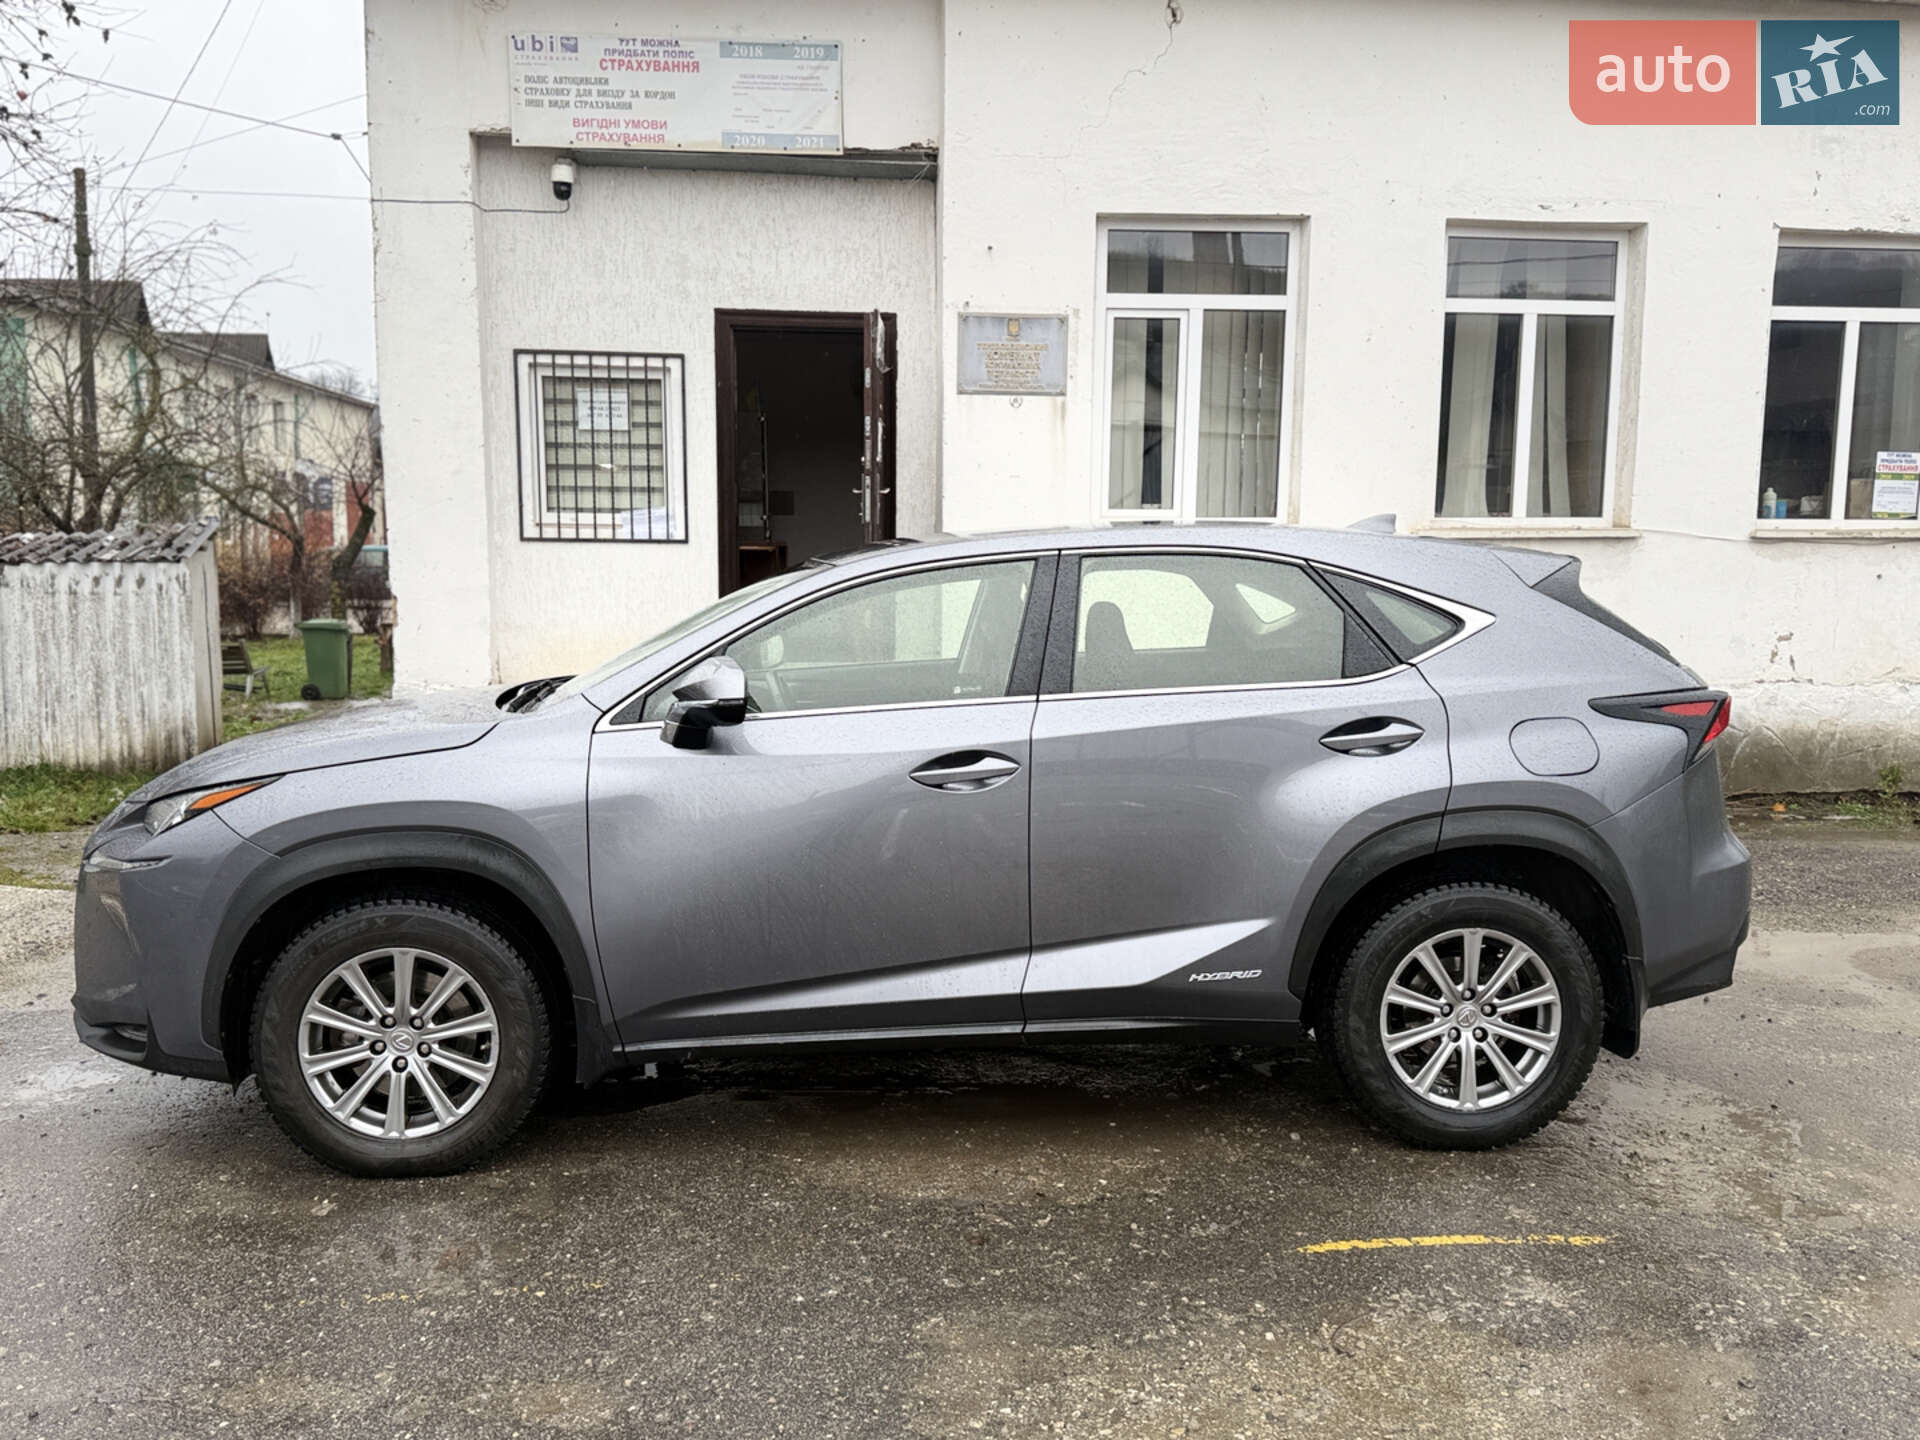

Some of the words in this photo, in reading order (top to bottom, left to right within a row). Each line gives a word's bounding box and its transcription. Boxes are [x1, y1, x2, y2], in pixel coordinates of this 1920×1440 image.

[513, 34, 554, 53] ubi
[618, 38, 638, 47] ТУТ
[640, 38, 681, 48] МОЖНА
[603, 48, 660, 58] ПРИДБАТИ
[663, 49, 696, 59] ПОЛІС
[732, 44, 763, 57] 2018
[794, 46, 825, 59] 2019
[599, 58, 700, 73] СТРАХУВАННЯ
[524, 74, 549, 85] ПОЛІС
[524, 86, 571, 97] СТРАХОВКУ
[575, 88, 593, 99] ДЛЯ
[629, 89, 641, 99] ЗА
[644, 89, 676, 101] КОРДОН
[548, 98, 570, 109] ВИДИ
[574, 99, 633, 111] СТРАХУВАННЯ
[572, 117, 621, 130] ВИГІДНІ
[623, 119, 668, 130] УМОВИ
[575, 131, 665, 144] СТРАХУВАННЯ
[734, 134, 766, 147] 2020
[795, 135, 825, 148] 2021
[1188, 969, 1263, 983] HYBRID
